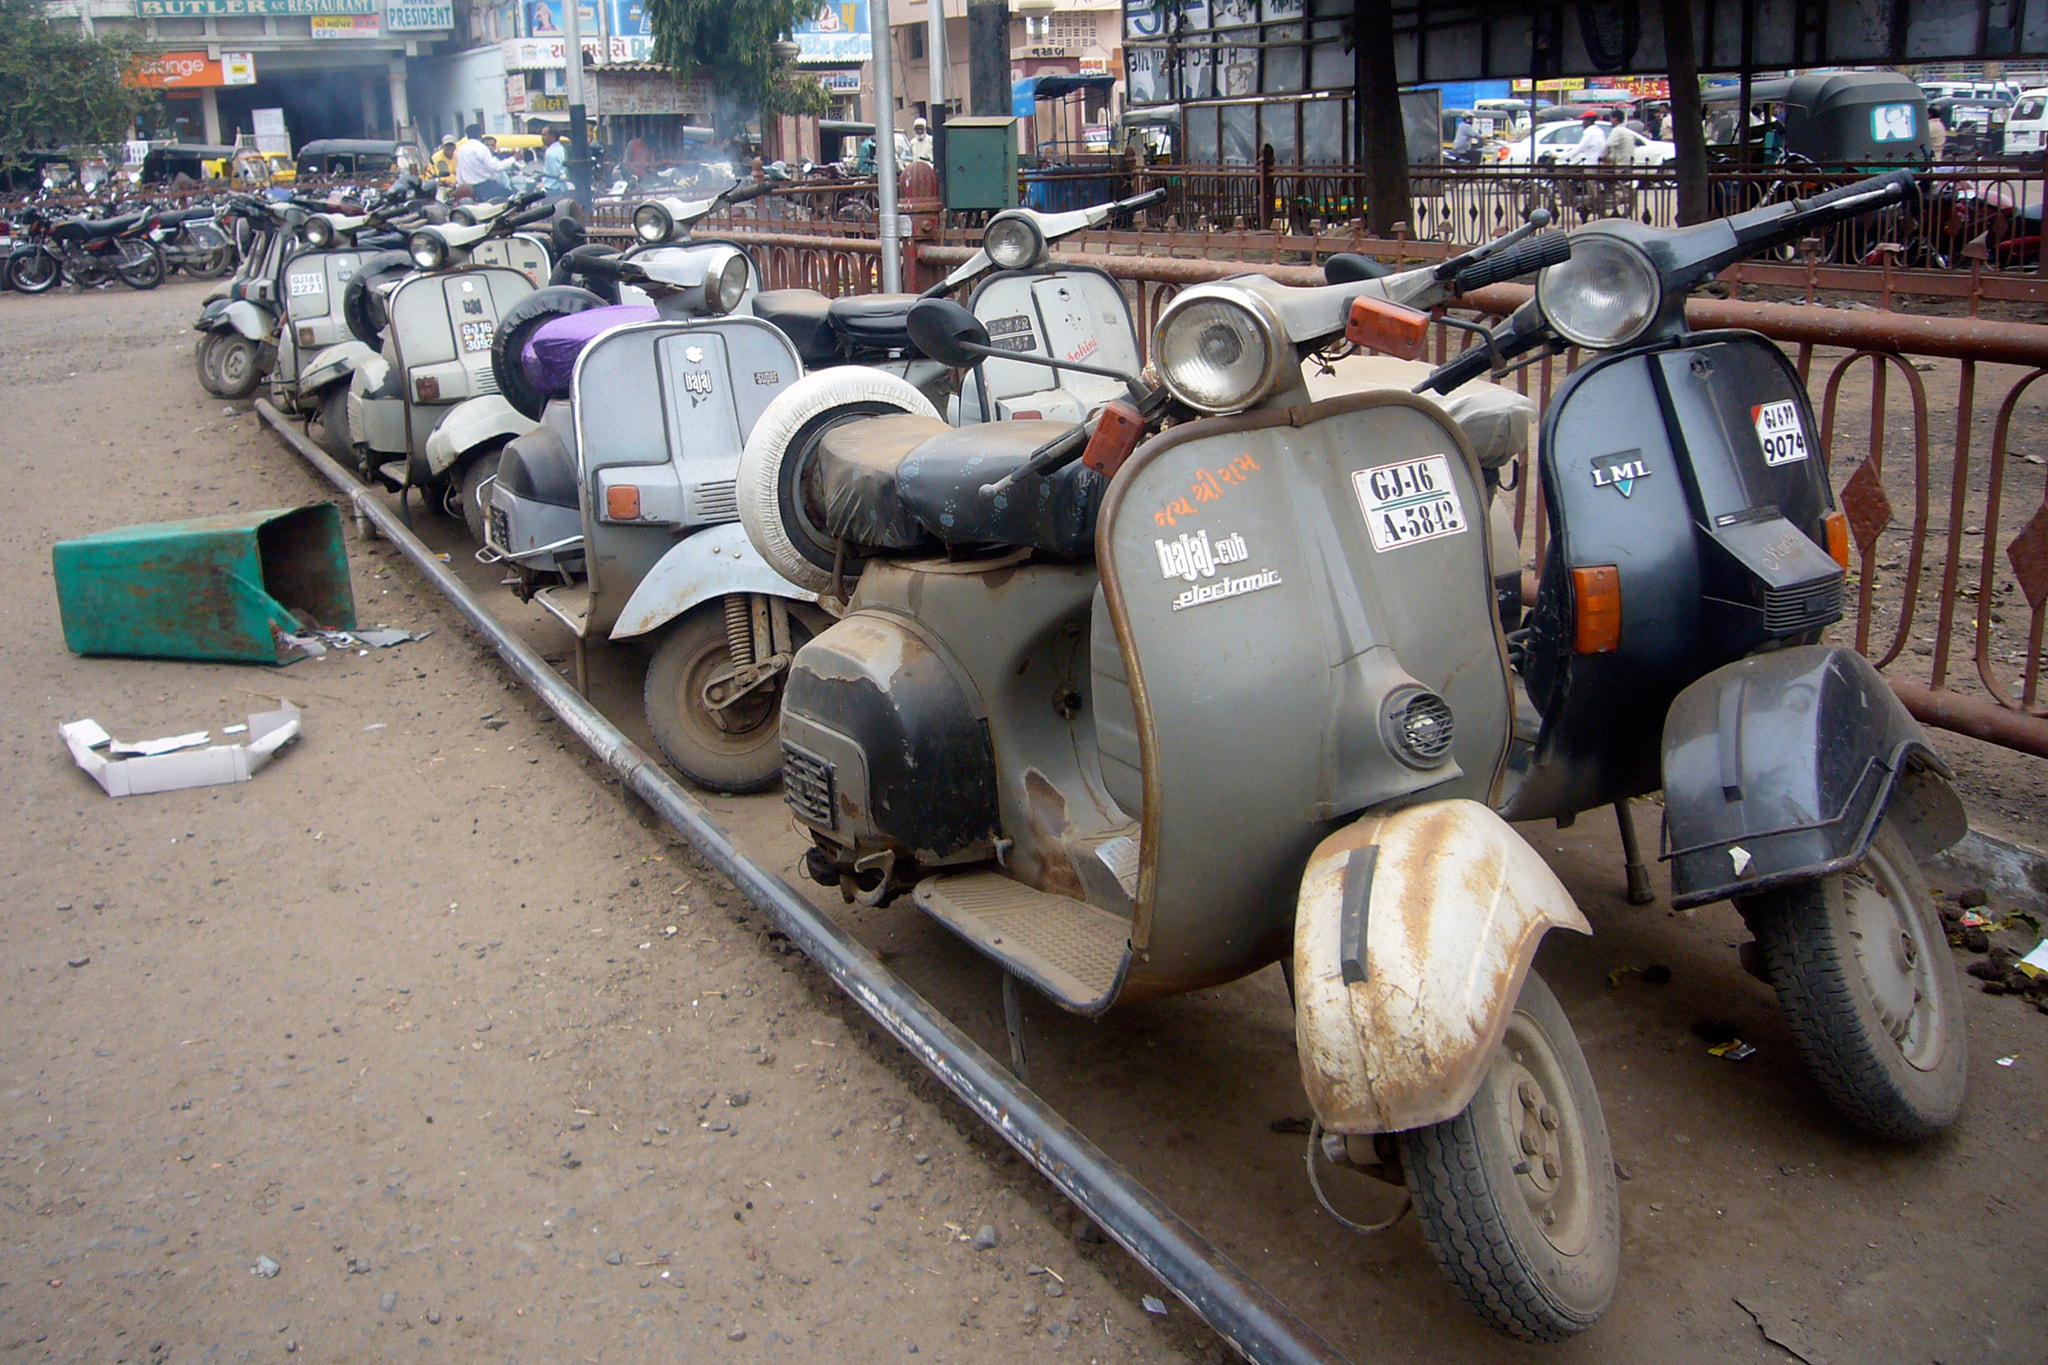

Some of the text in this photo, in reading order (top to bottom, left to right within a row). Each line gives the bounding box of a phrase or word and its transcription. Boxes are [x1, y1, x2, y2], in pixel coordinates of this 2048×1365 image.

[142, 0, 267, 14] BUTLER
[288, 0, 368, 12] RESTAURANT
[389, 6, 450, 27] PRESIDENT
[293, 283, 322, 293] 2271
[683, 370, 713, 394] bajaj
[1763, 432, 1805, 462] 9074
[1591, 460, 1652, 487] LML
[1172, 568, 1282, 612] electronic
